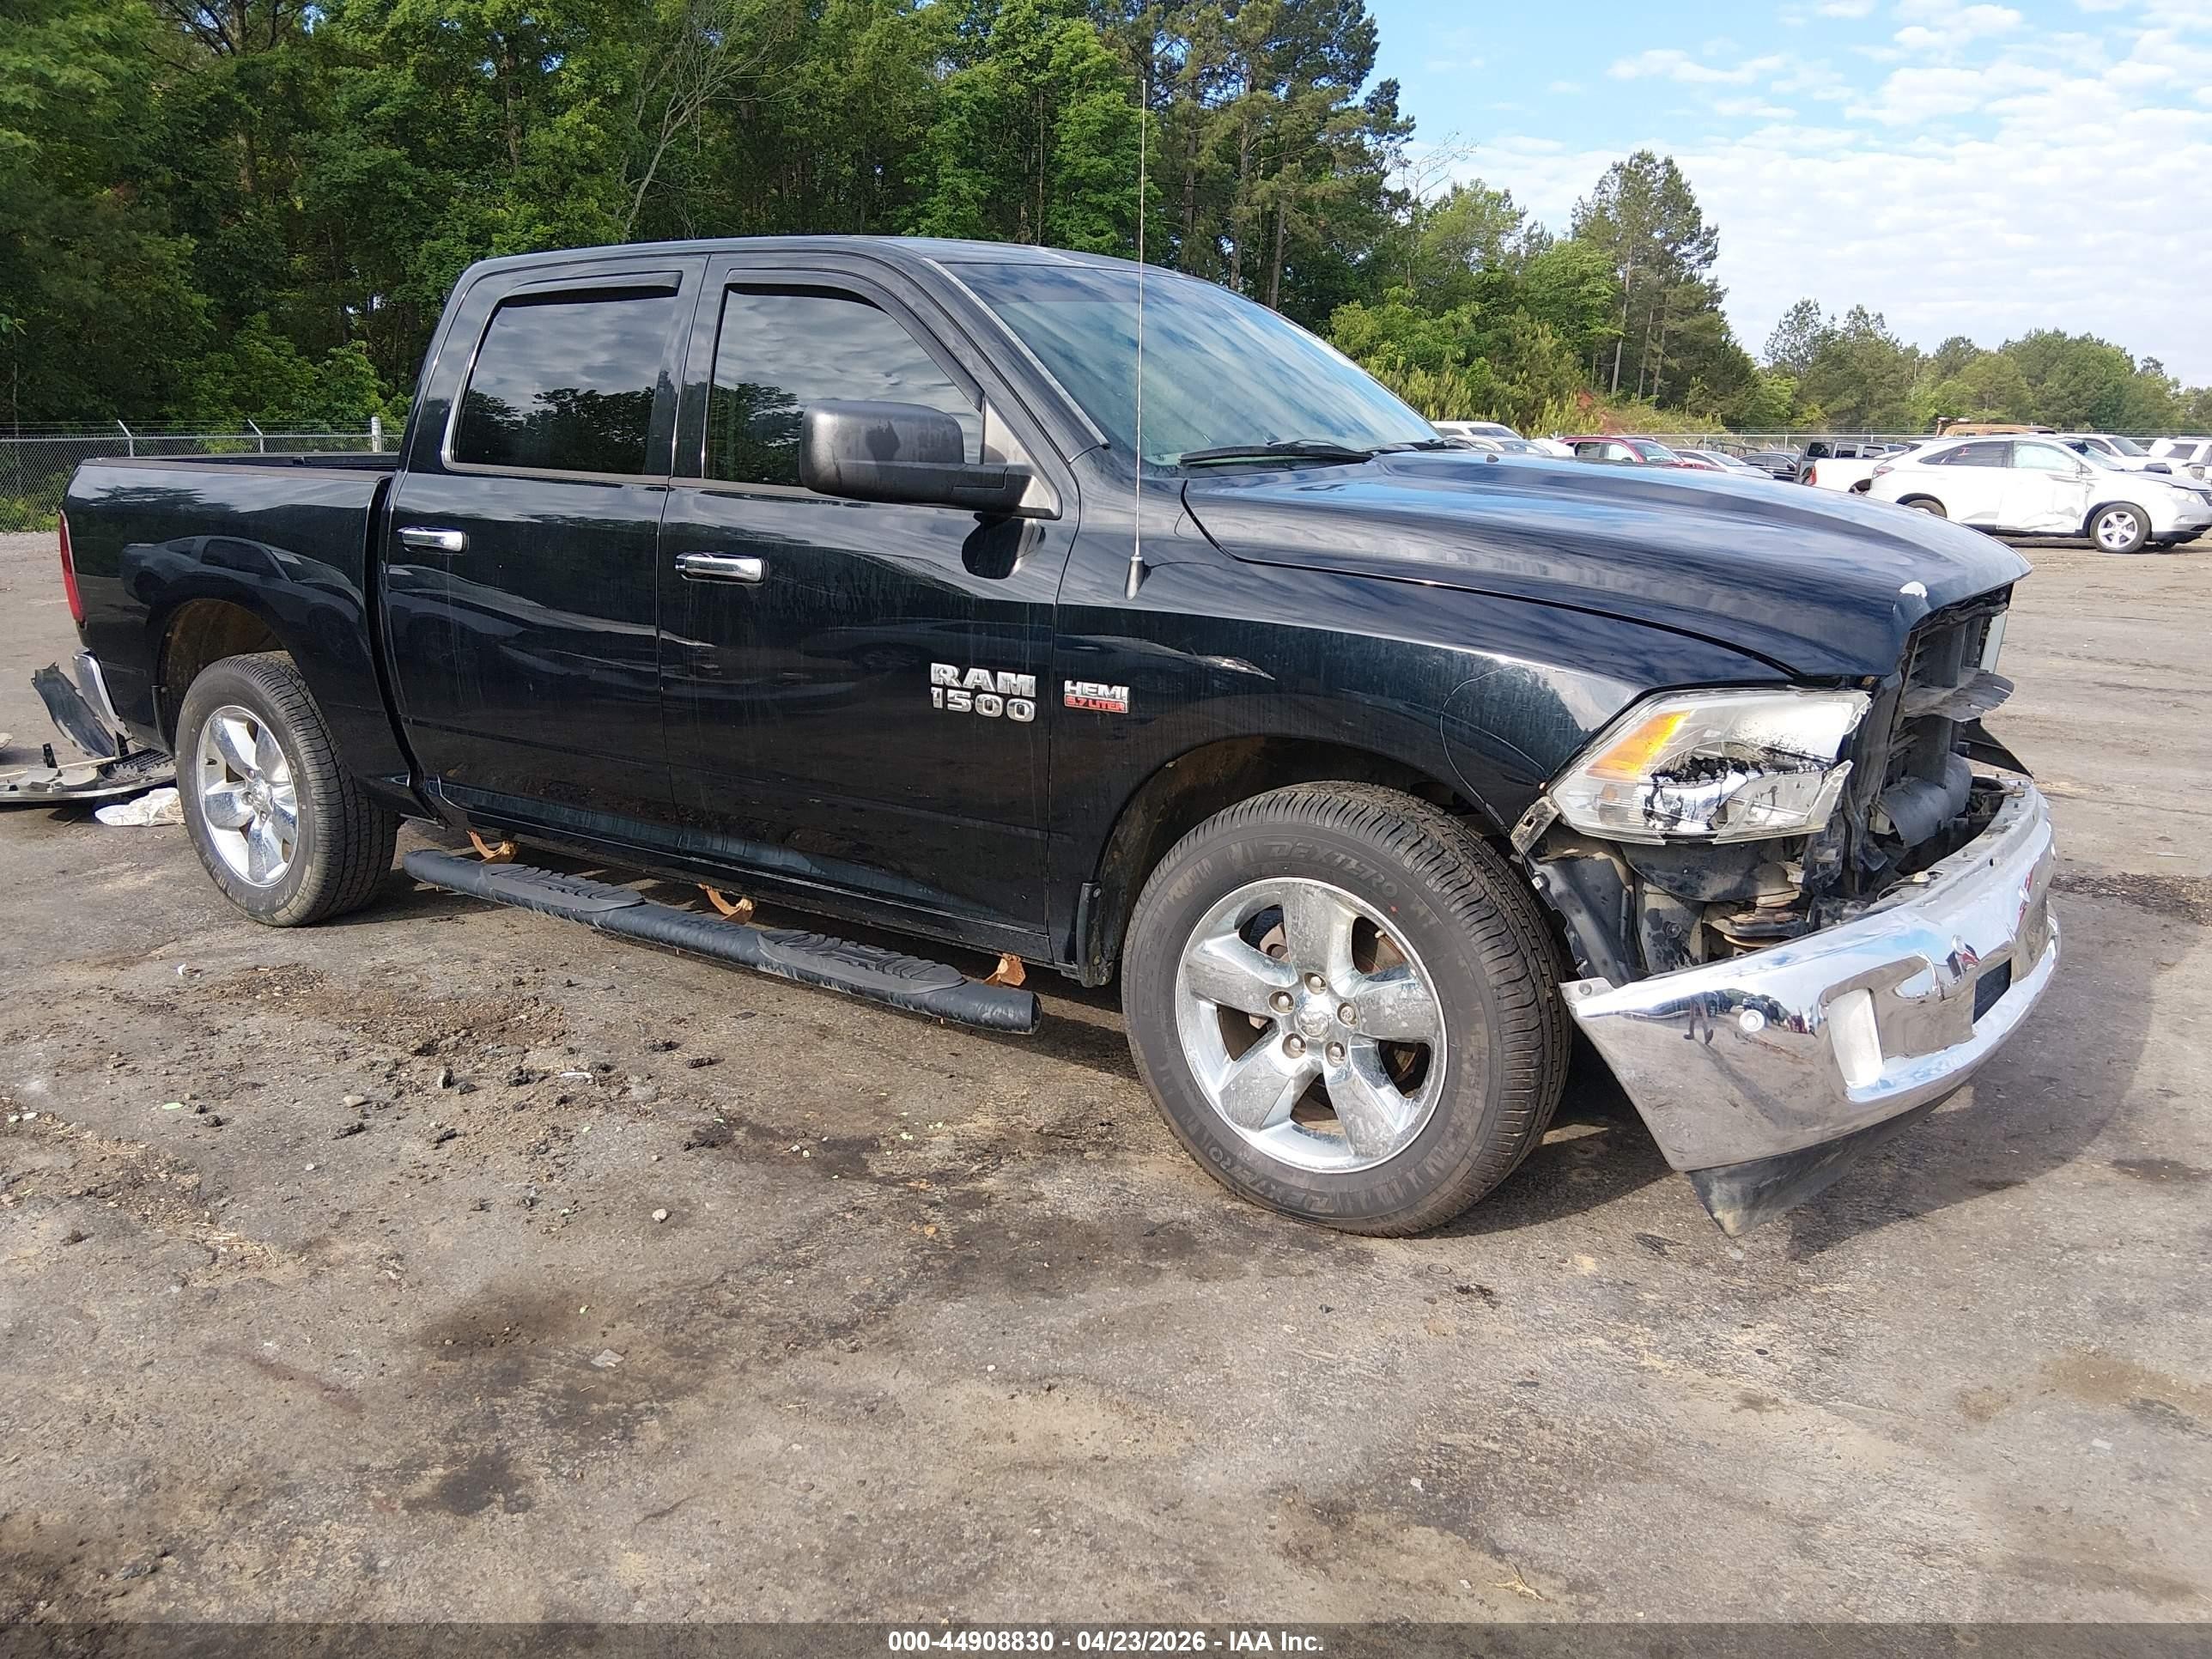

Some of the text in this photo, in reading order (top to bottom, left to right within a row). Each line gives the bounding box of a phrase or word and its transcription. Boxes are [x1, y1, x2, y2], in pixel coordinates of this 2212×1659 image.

[931, 663, 1036, 697] RAM
[1064, 680, 1129, 701] HEMI
[931, 687, 1036, 723] 1500
[1066, 696, 1126, 711] 5.7 LITER
